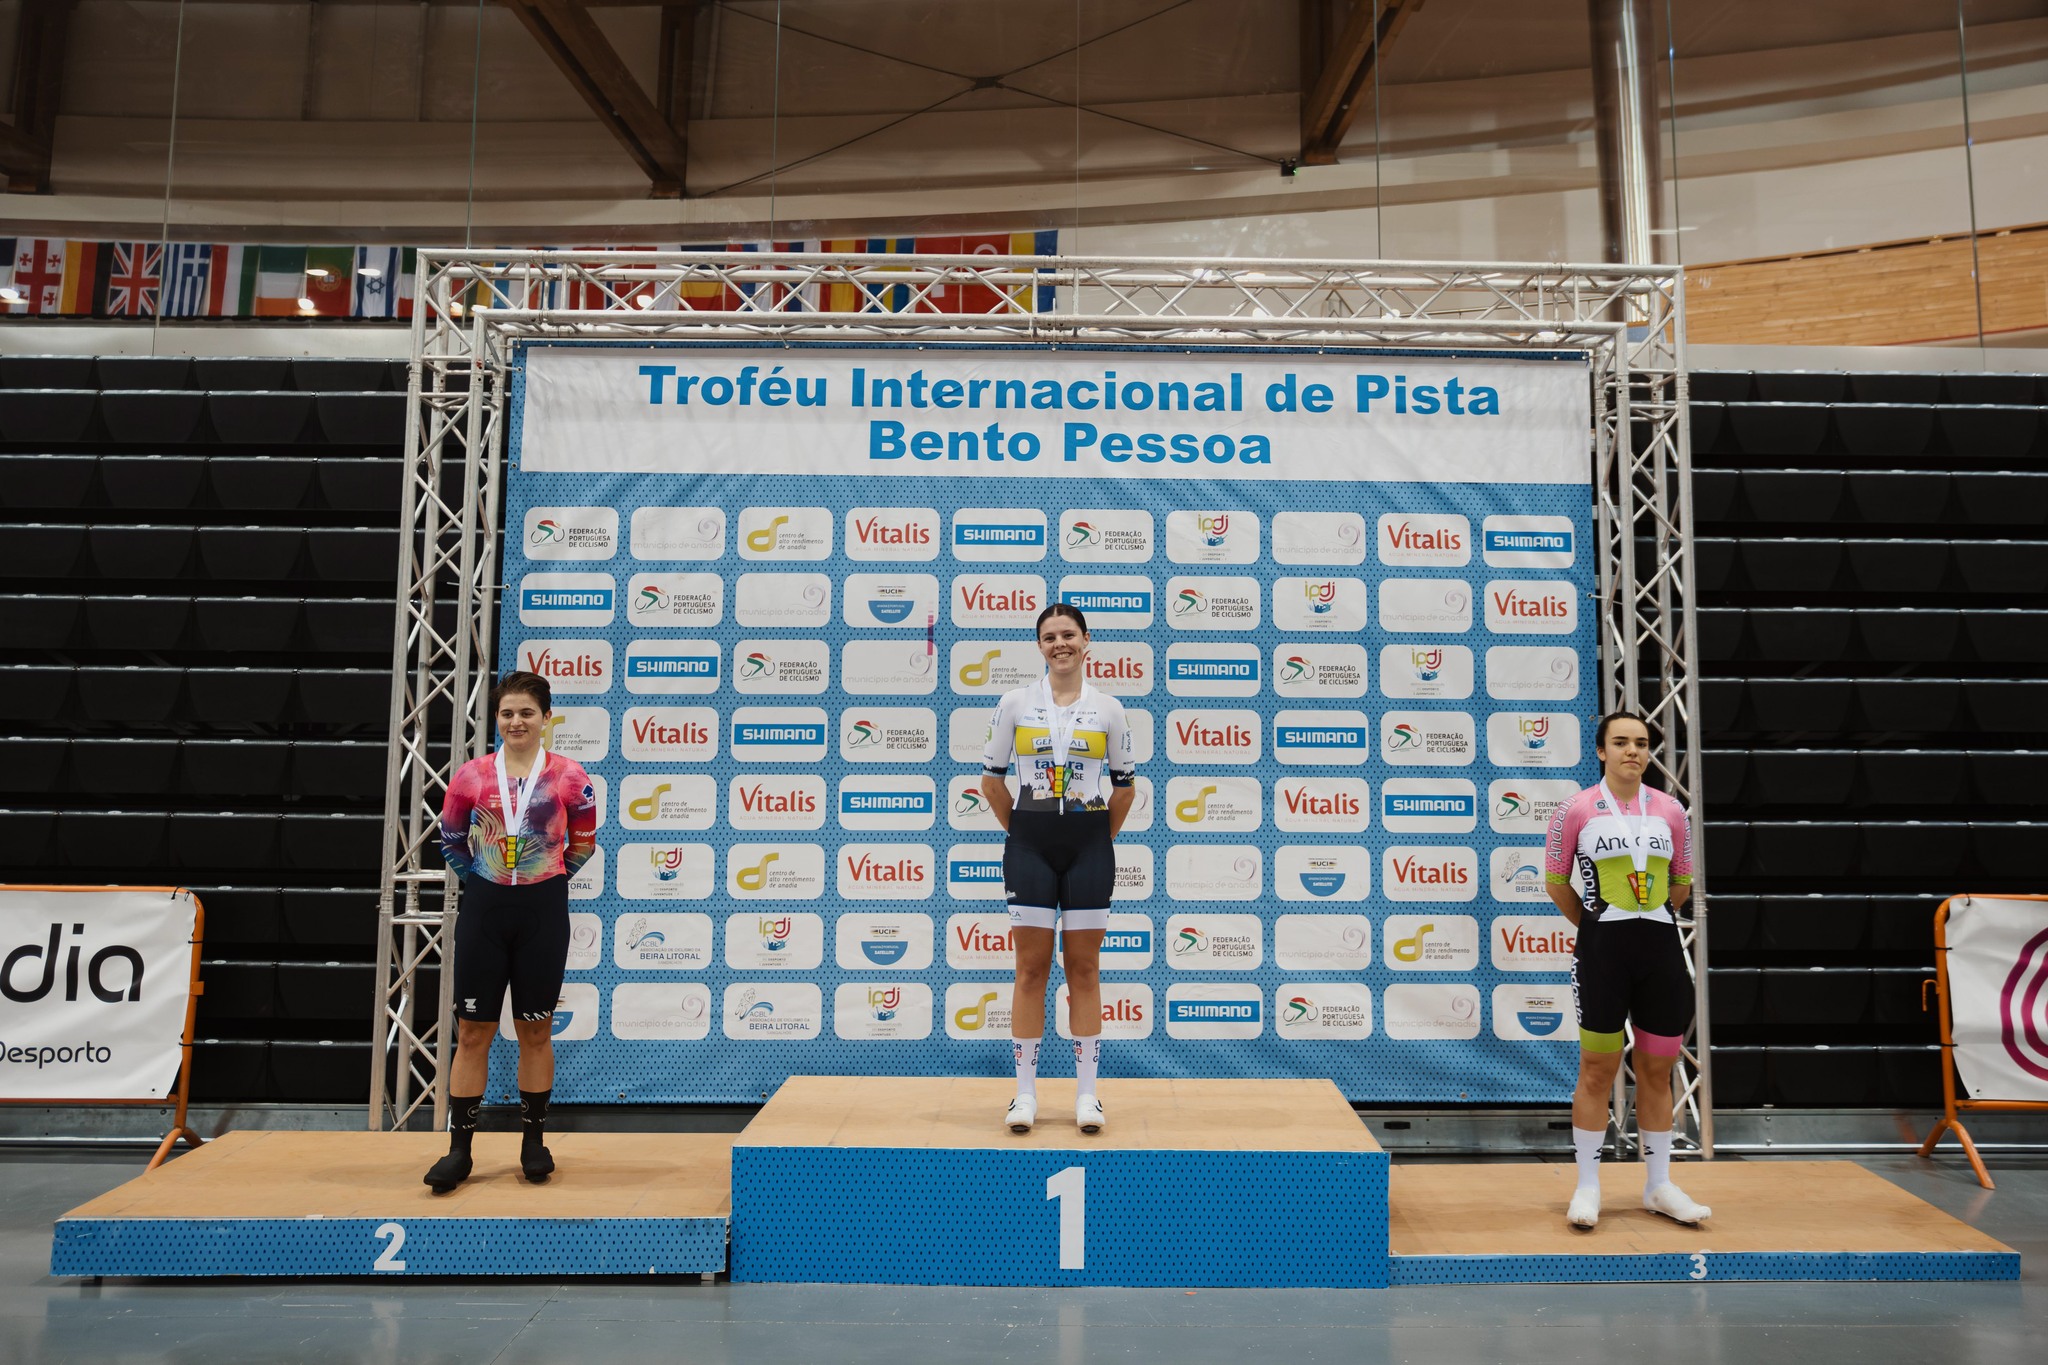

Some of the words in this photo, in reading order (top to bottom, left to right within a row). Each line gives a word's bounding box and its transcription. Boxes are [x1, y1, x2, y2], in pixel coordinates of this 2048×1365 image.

[639, 366, 827, 406] Troféu
[852, 368, 1241, 412] Internacional
[1265, 373, 1334, 413] de
[1356, 375, 1500, 415] Pista
[869, 420, 1041, 461] Bento
[1064, 422, 1271, 464] Pessoa
[568, 527, 607, 535] FEDERAÇÃO
[855, 516, 930, 544] Vitalis
[963, 529, 1036, 541] SHIMANO
[1104, 530, 1143, 538] FEDERAÇÃO
[1198, 514, 1229, 535] ipdj
[1387, 522, 1461, 549] Vitalis
[1493, 536, 1564, 547] SHIMANO
[531, 594, 604, 606] SHIMANO
[673, 594, 712, 602] FEDERAÇÃO
[961, 583, 1036, 611] Vitalis
[1070, 596, 1143, 608] SHIMANO
[1211, 597, 1249, 605] FEDERAÇÃO
[1305, 581, 1336, 602] ipdj
[1494, 589, 1568, 617] Vitalis
[527, 648, 603, 677] Vitalis
[636, 661, 710, 673] SHIMANO
[779, 661, 818, 669] FEDERAÇÃO
[1081, 650, 1143, 679] italis
[1318, 664, 1357, 673] FEDERAÇÃO
[1411, 648, 1442, 669] ipdj
[890, 675, 902, 683] de
[1177, 664, 1250, 676] SHIMANO
[632, 715, 708, 744] Vitalis
[742, 728, 816, 740] SHIMANO
[886, 728, 925, 736] FEDERAÇÃO
[1176, 718, 1251, 746] Vitalis
[1285, 731, 1358, 743] SHIMANO
[1425, 732, 1464, 740] FEDERAÇÃO
[1518, 716, 1549, 737] ipdj
[739, 783, 816, 812] Vitalis
[850, 796, 924, 809] SHIMANO
[1284, 786, 1360, 815] Vitalis
[1392, 800, 1466, 812] SHIMANO
[650, 847, 682, 869] ipdj
[847, 852, 924, 882] Vitalis
[958, 866, 1002, 878] SHIM
[1392, 855, 1468, 884] Vitalis
[759, 916, 791, 939] ipdj
[956, 922, 1013, 952] Vital
[1212, 935, 1252, 944] FEDERAÇÃO
[1500, 924, 1577, 954] Vitalis
[1324, 950, 1336, 958] de
[868, 986, 900, 1009] ipdj
[1177, 1005, 1252, 1018] SHIMANO
[1321, 1005, 1361, 1013] FEDERAÇÃO
[661, 1019, 674, 1028] de
[1047, 1167, 1085, 1269] 1
[373, 1222, 406, 1271] 2
[1689, 1254, 1707, 1279] 3
